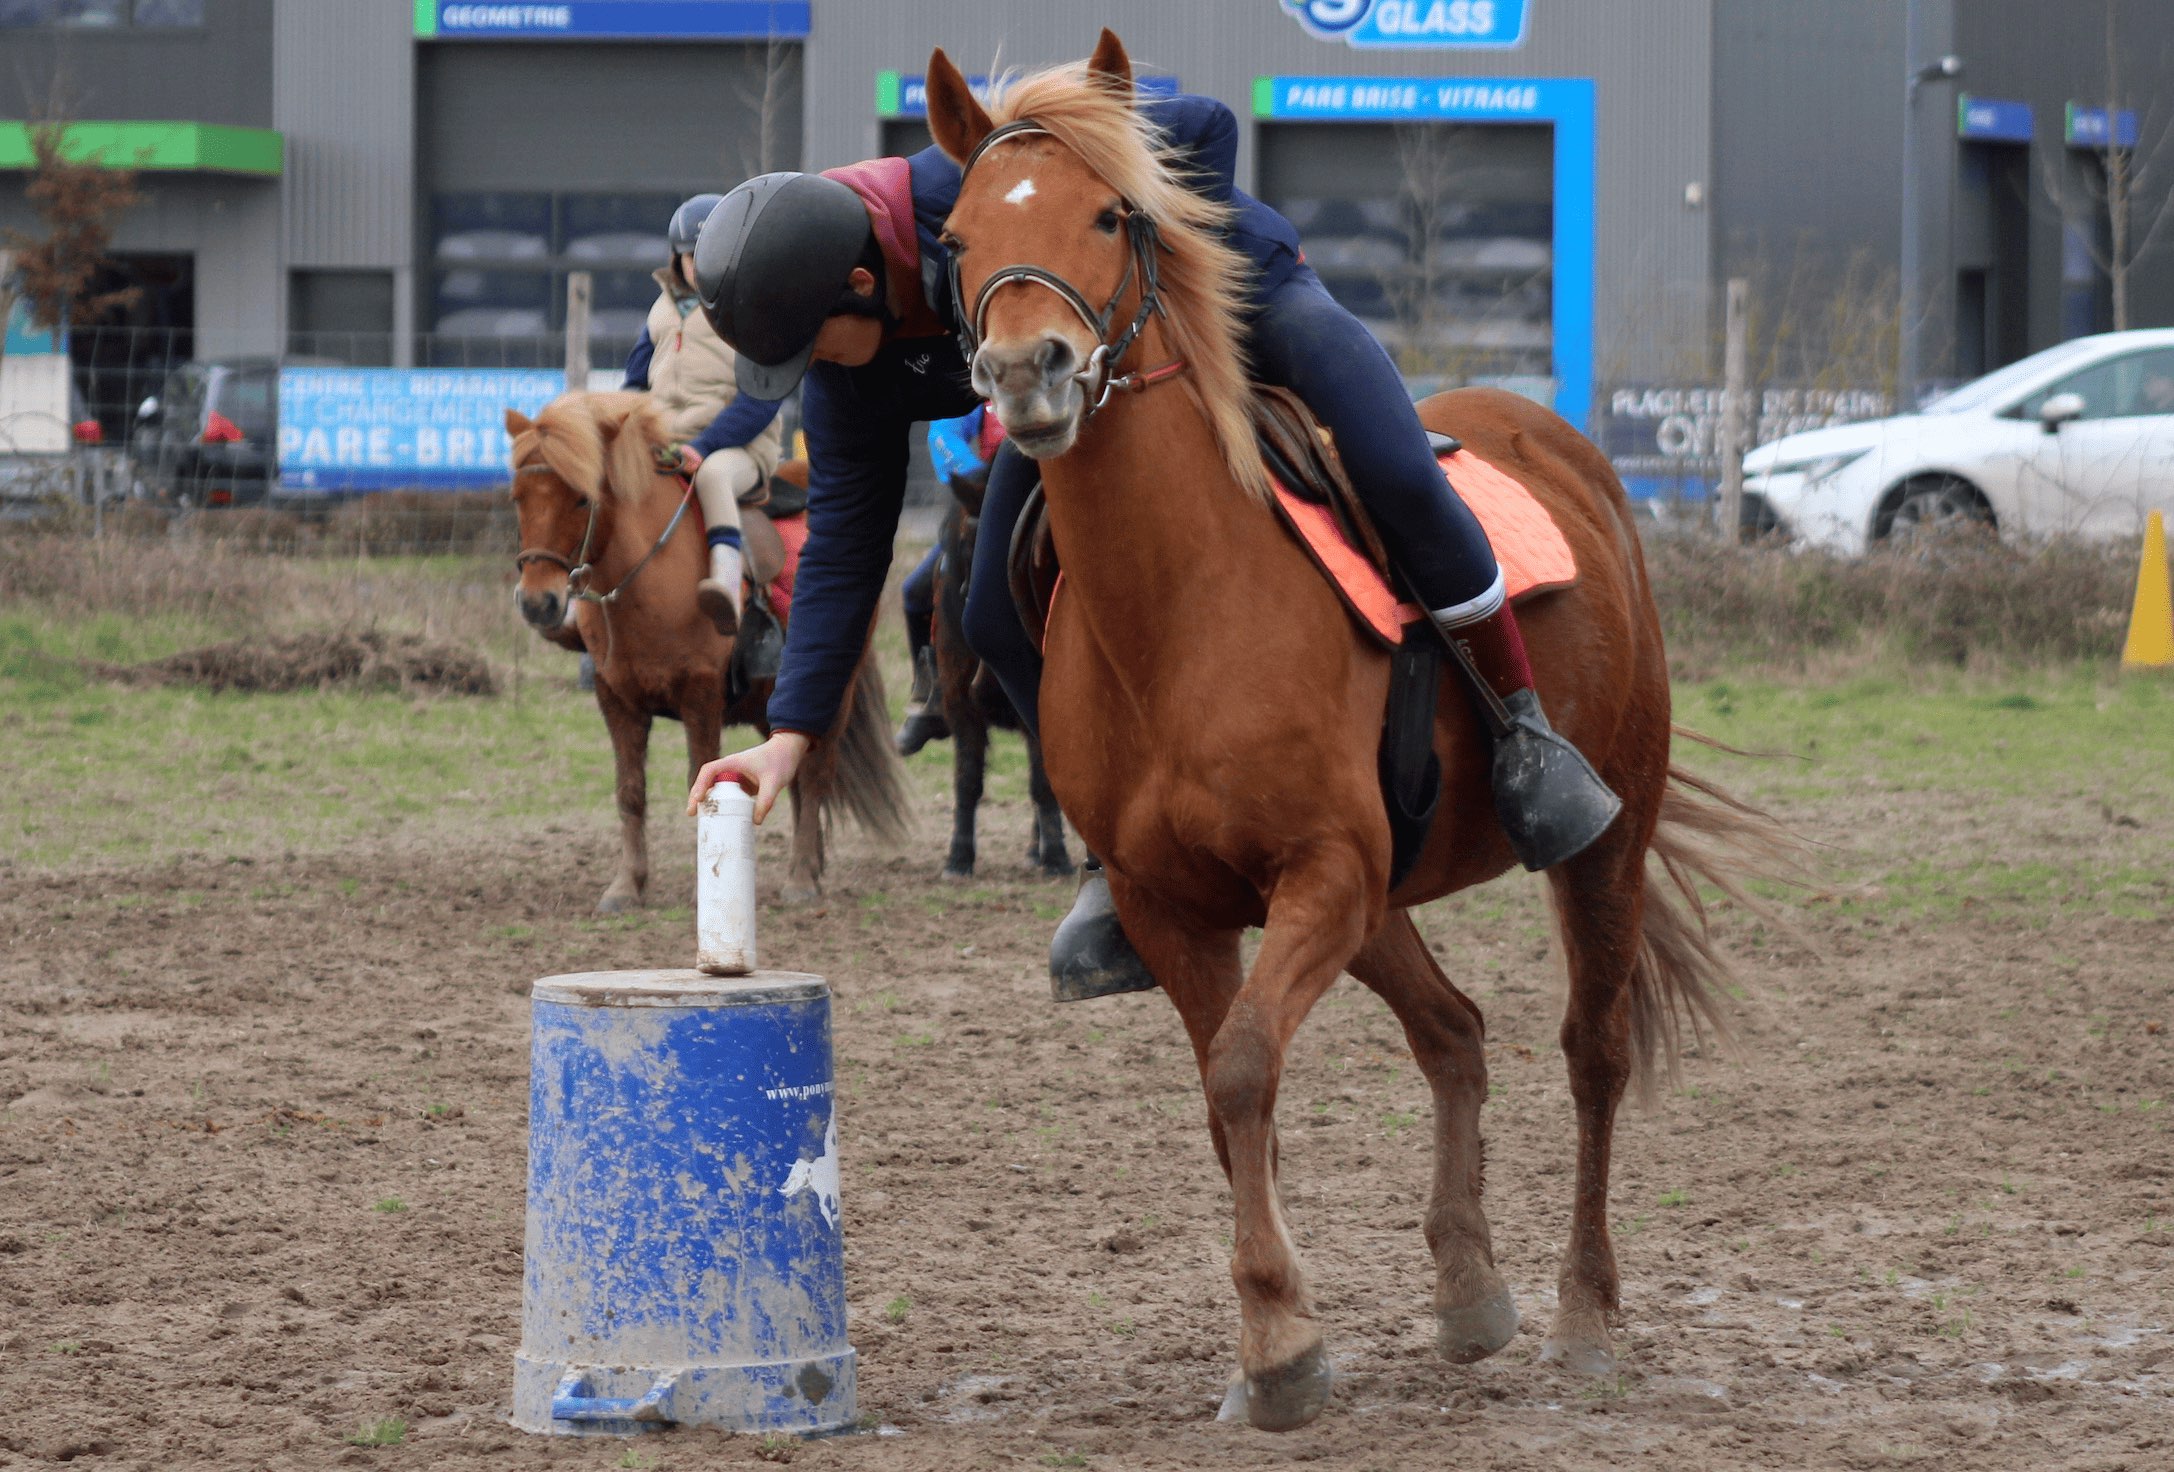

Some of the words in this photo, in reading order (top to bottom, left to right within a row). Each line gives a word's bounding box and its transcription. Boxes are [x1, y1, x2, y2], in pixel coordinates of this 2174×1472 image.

[1376, 0, 1494, 34] GLASS
[1287, 86, 1346, 109] PARE
[1351, 86, 1418, 109] BRISE
[1438, 87, 1536, 109] VITRAGE
